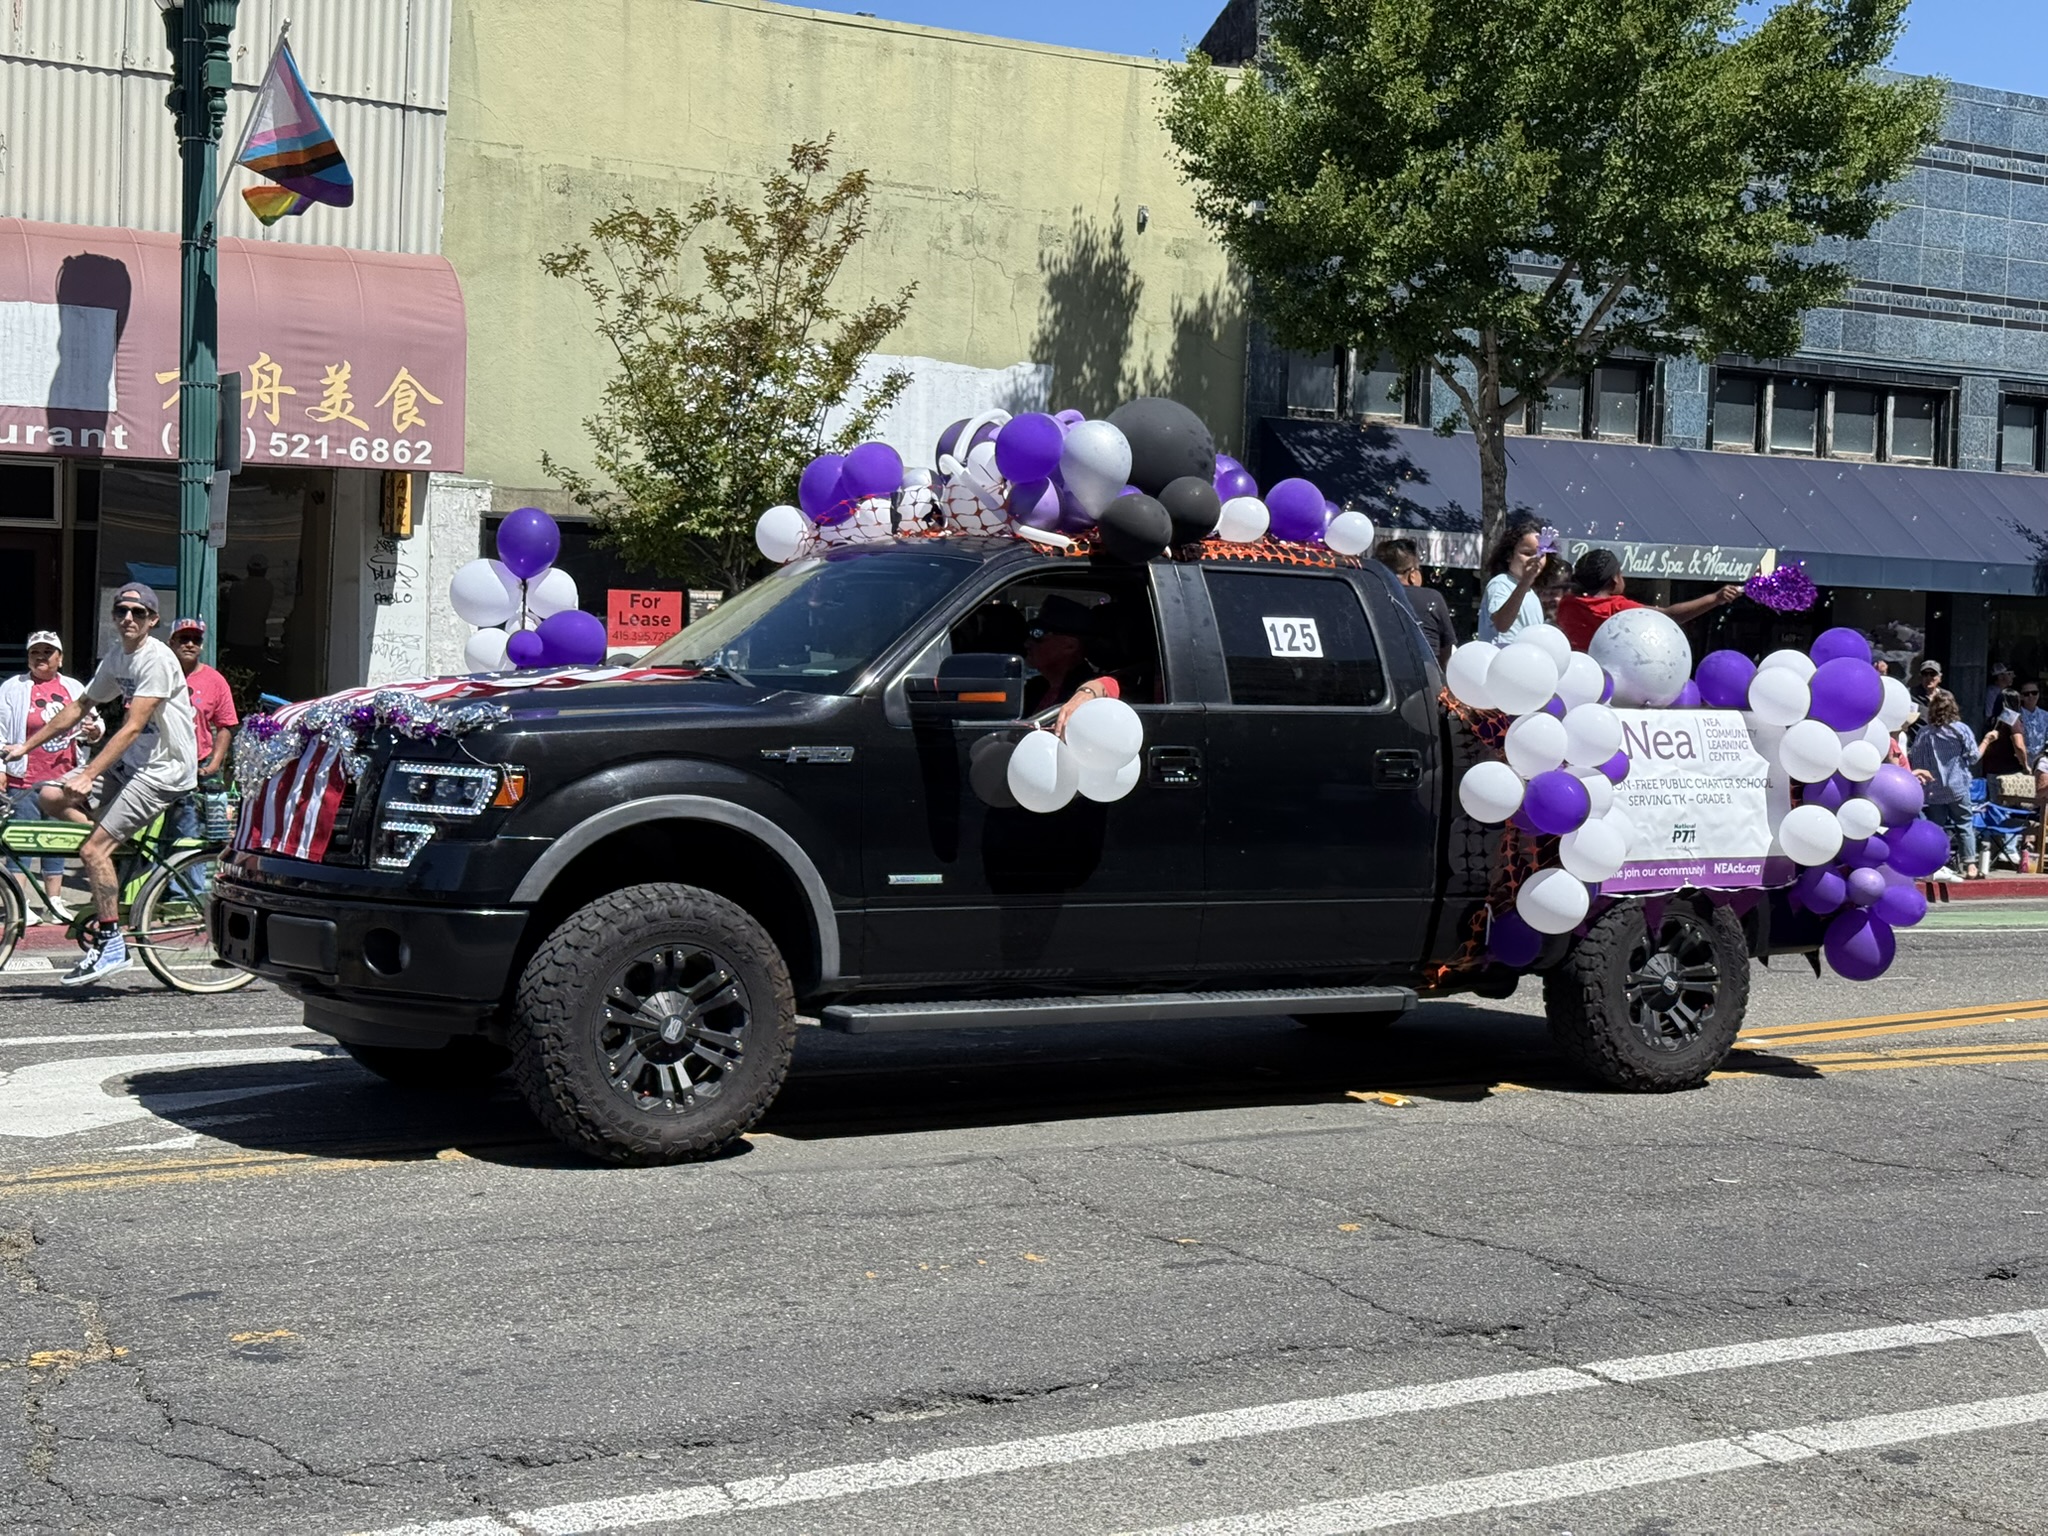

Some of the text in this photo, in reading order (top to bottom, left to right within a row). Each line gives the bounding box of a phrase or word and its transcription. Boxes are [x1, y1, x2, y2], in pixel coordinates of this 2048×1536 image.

[155, 351, 444, 434] 舟美食
[268, 432, 433, 465] 521-6862
[1620, 545, 1655, 573] Nail
[1657, 550, 1685, 578] Spa
[1688, 551, 1701, 575] &
[1702, 550, 1754, 582] Waxing
[630, 593, 661, 609] For
[619, 611, 671, 627] Lease
[1269, 623, 1316, 652] 125
[1703, 718, 1721, 727] NEA
[1621, 720, 1697, 760] Nea
[1705, 728, 1758, 739] COMMUNITY
[1708, 740, 1749, 750] LEARNING
[1709, 751, 1741, 761] CENTER
[1660, 778, 1693, 790] PUBLIC
[1695, 778, 1734, 789] CHARTER
[1736, 777, 1774, 789] SCHOOL
[1628, 794, 1671, 806] SERVING
[1672, 794, 1686, 805] TK
[1696, 793, 1725, 804] GRADE
[1624, 867, 1640, 880] join
[1642, 868, 1657, 877] our
[1713, 862, 1761, 876] NEAclc.org
